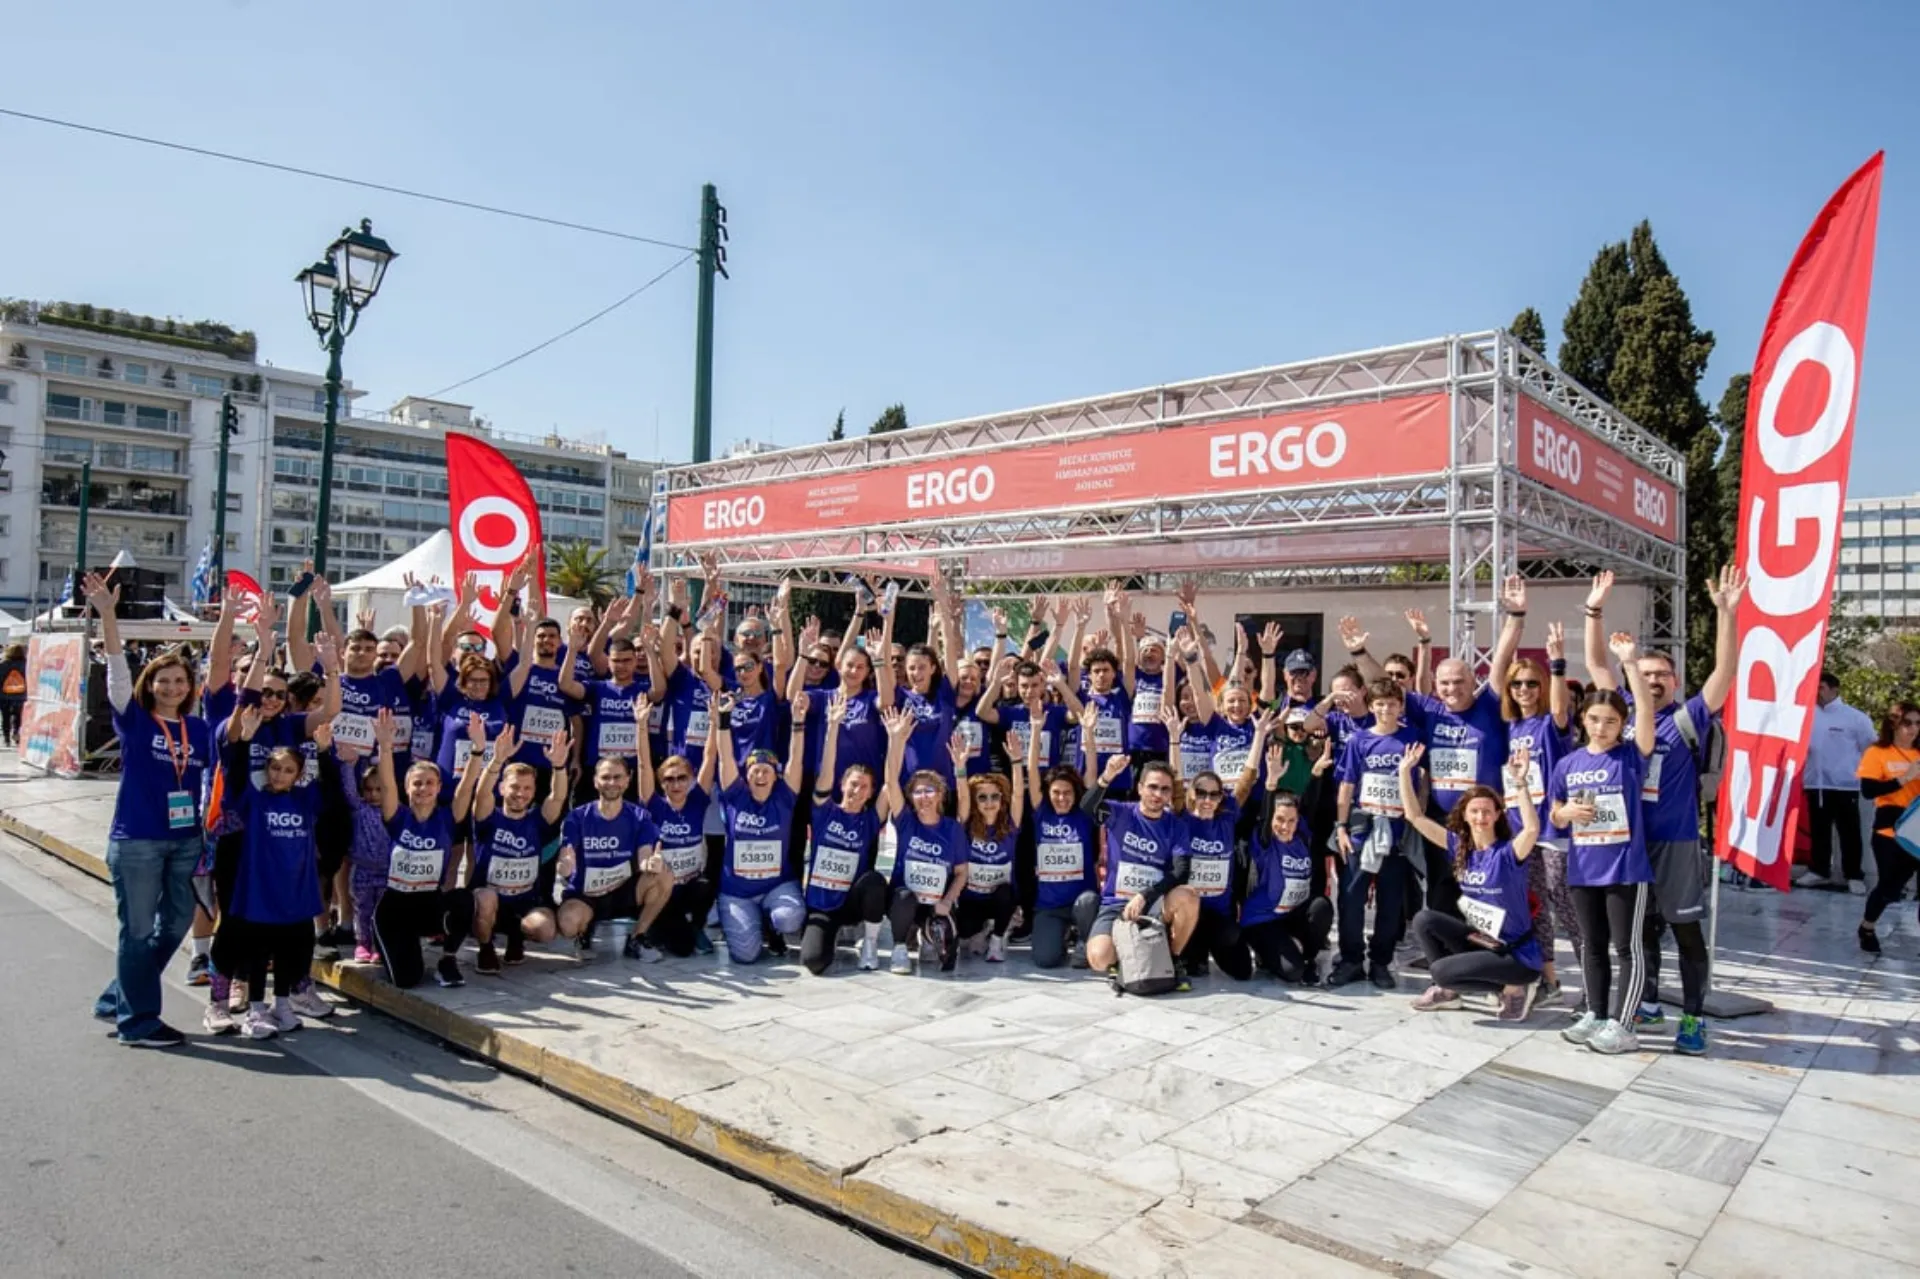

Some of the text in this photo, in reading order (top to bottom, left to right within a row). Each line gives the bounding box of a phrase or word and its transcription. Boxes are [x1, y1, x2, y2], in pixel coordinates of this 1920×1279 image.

[1209, 421, 1347, 478] ERGO
[1533, 418, 1581, 486] ERGO
[907, 465, 995, 508] ERGO
[1634, 478, 1667, 527] ERGO
[703, 495, 765, 530] ERGO
[1728, 320, 1856, 865] ERGO
[333, 724, 368, 739] 51761
[1365, 753, 1402, 769] ERGO
[1433, 761, 1469, 773] 55649
[1566, 768, 1609, 787] ERGO
[1366, 786, 1400, 800] 55651
[583, 835, 620, 851] ERGO
[1123, 830, 1159, 854] ERGO
[1190, 836, 1225, 854] ERGO
[740, 852, 775, 864] 53839
[397, 861, 435, 876] 56230
[909, 873, 941, 889] 55362
